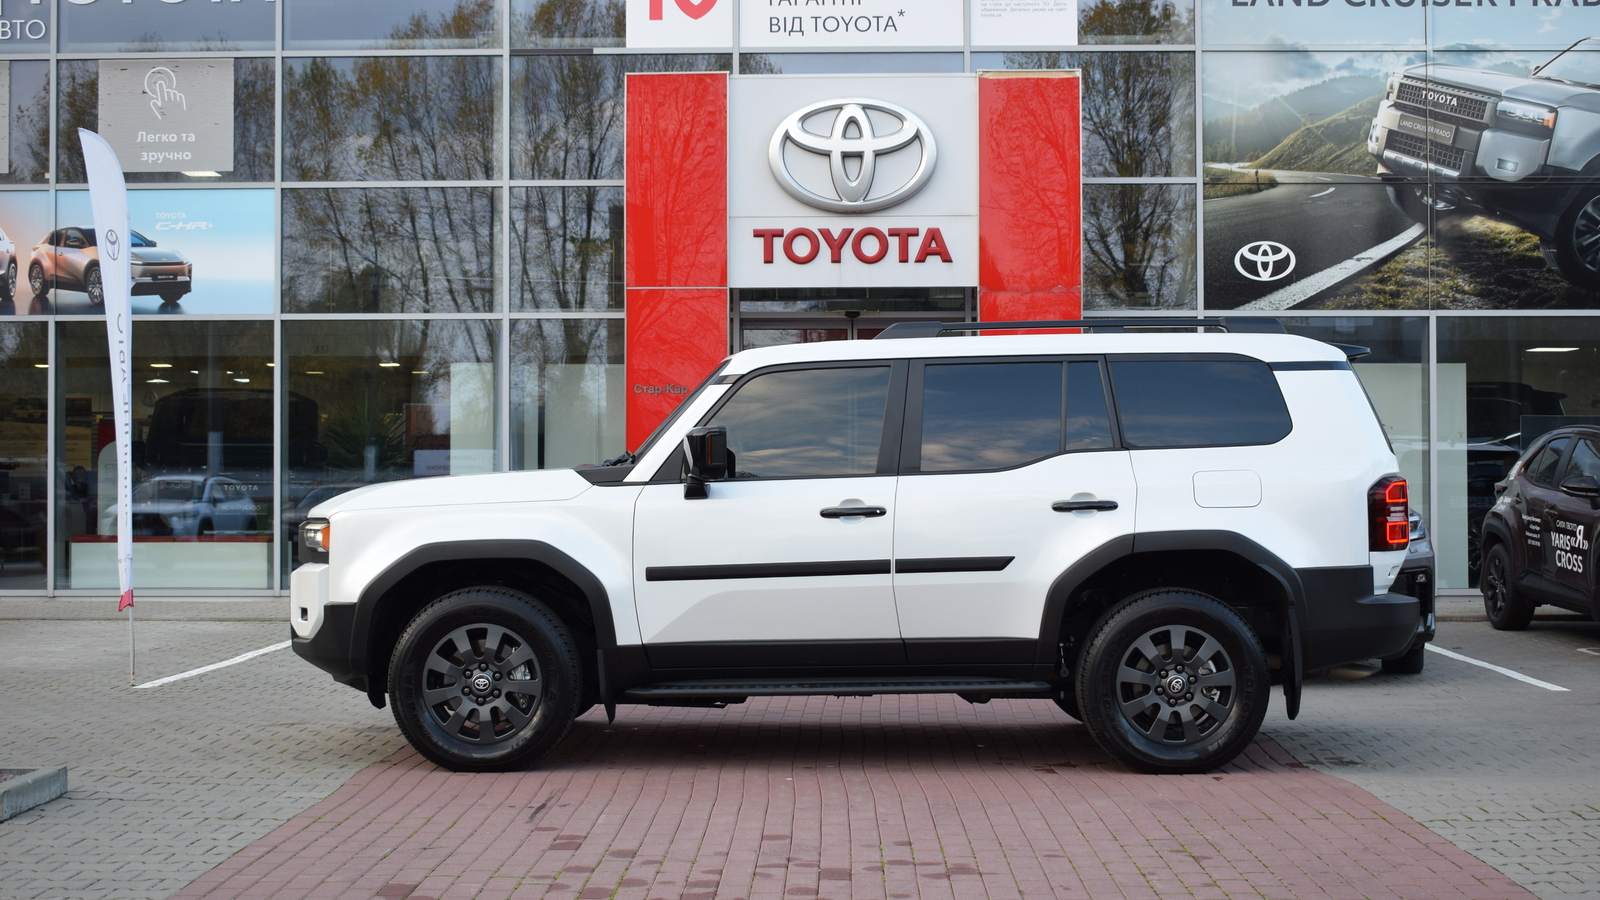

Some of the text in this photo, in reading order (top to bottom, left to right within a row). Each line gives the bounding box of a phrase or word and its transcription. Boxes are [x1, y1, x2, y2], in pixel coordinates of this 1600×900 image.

[769, 16, 805, 37] ВІД
[1422, 90, 1457, 107] TOYOTA
[1400, 120, 1413, 128] LAND
[136, 131, 196, 143] Легко та
[140, 151, 192, 164] зручно
[155, 221, 214, 230] C-HR+
[753, 227, 953, 264] TOYOTA
[633, 383, 689, 396] Стар-Кар
[1551, 531, 1571, 551] YARIS
[1555, 549, 1583, 573] CROSS
